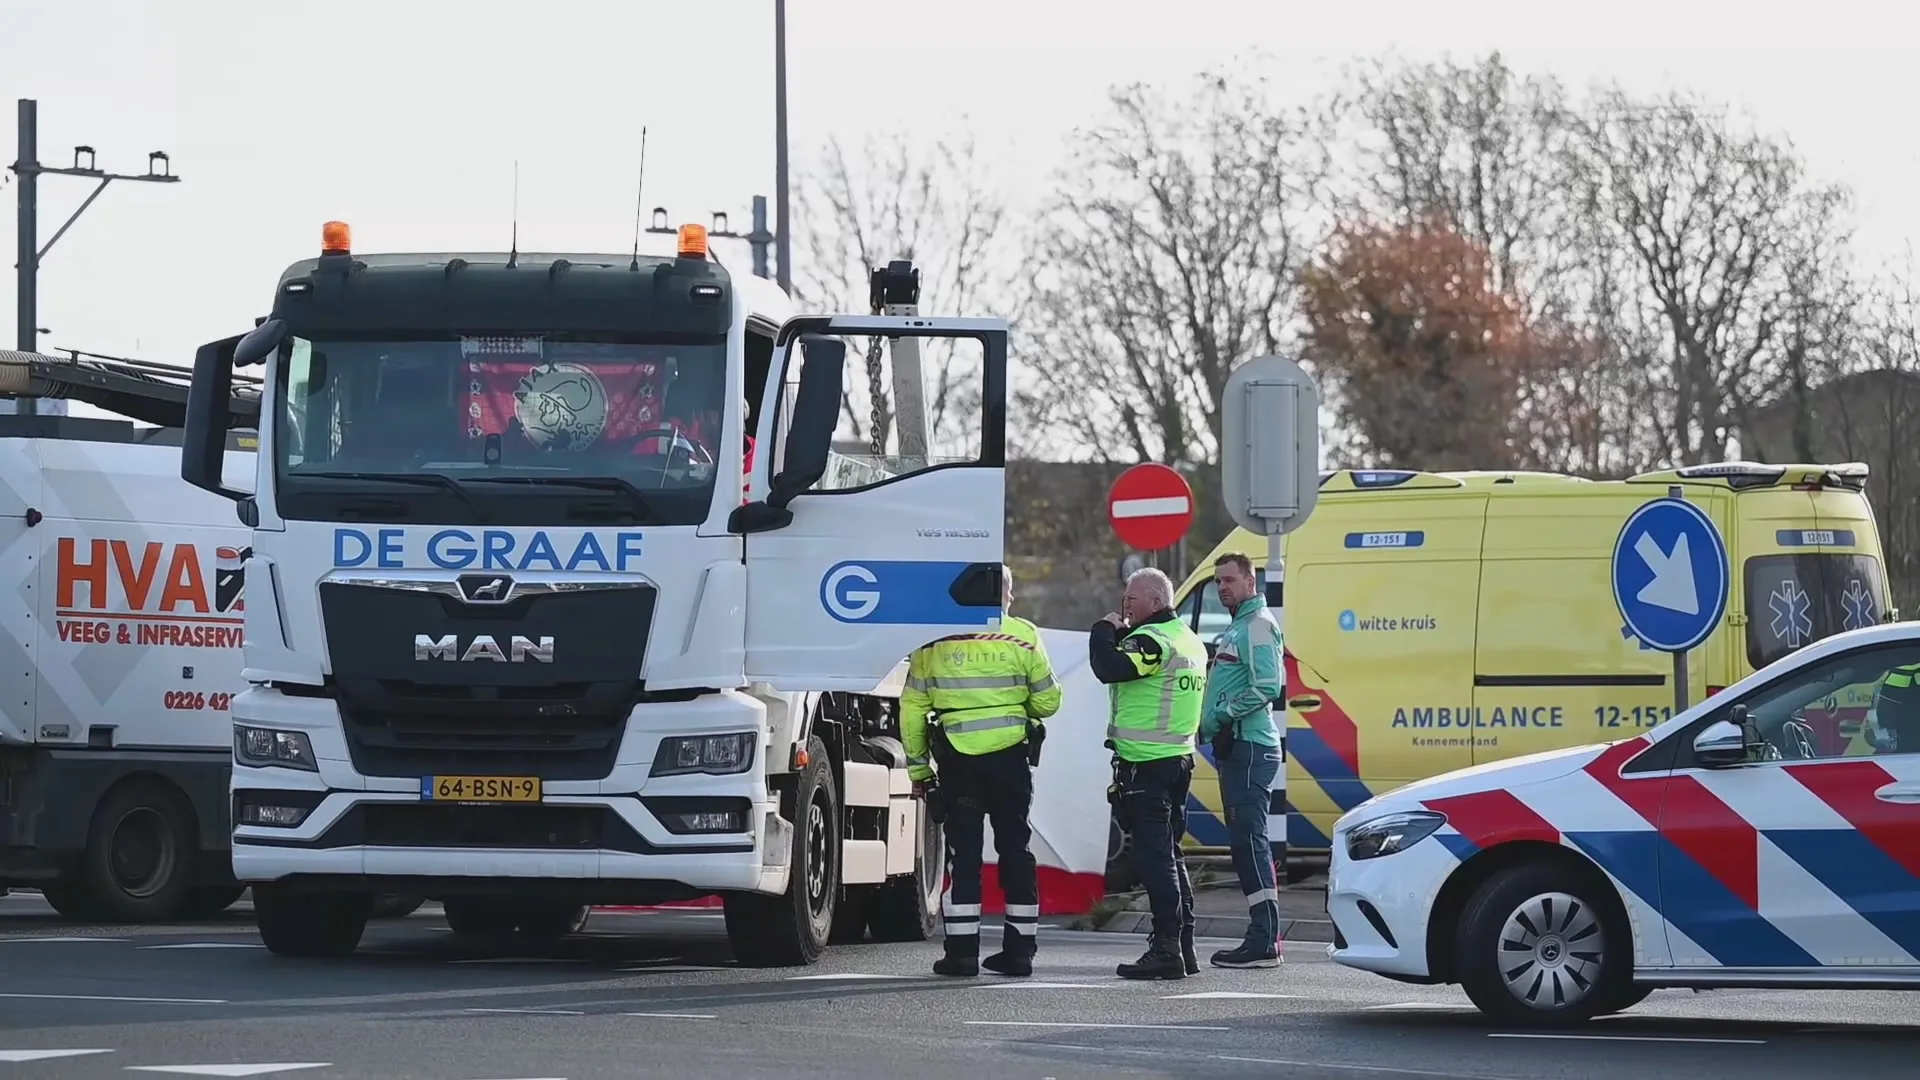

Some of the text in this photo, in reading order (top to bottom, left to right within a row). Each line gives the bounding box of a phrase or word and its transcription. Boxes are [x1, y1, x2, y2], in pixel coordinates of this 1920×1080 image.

[512, 361, 559, 404] AJAX
[334, 529, 642, 571] DE GRAAF
[1369, 535, 1400, 544] 12-151
[56, 537, 210, 613] HVA
[825, 565, 881, 619] G
[1359, 614, 1436, 630] witte kruis
[56, 620, 243, 649] VEEG & INFRASERVI
[415, 634, 554, 663] MAN
[1179, 675, 1206, 691] OVD
[164, 691, 236, 711] 0226 42
[1391, 705, 1673, 729] AMBULANCE 12-151
[1412, 736, 1498, 747] Kennemerland
[438, 779, 534, 798] 64-BSN-9
